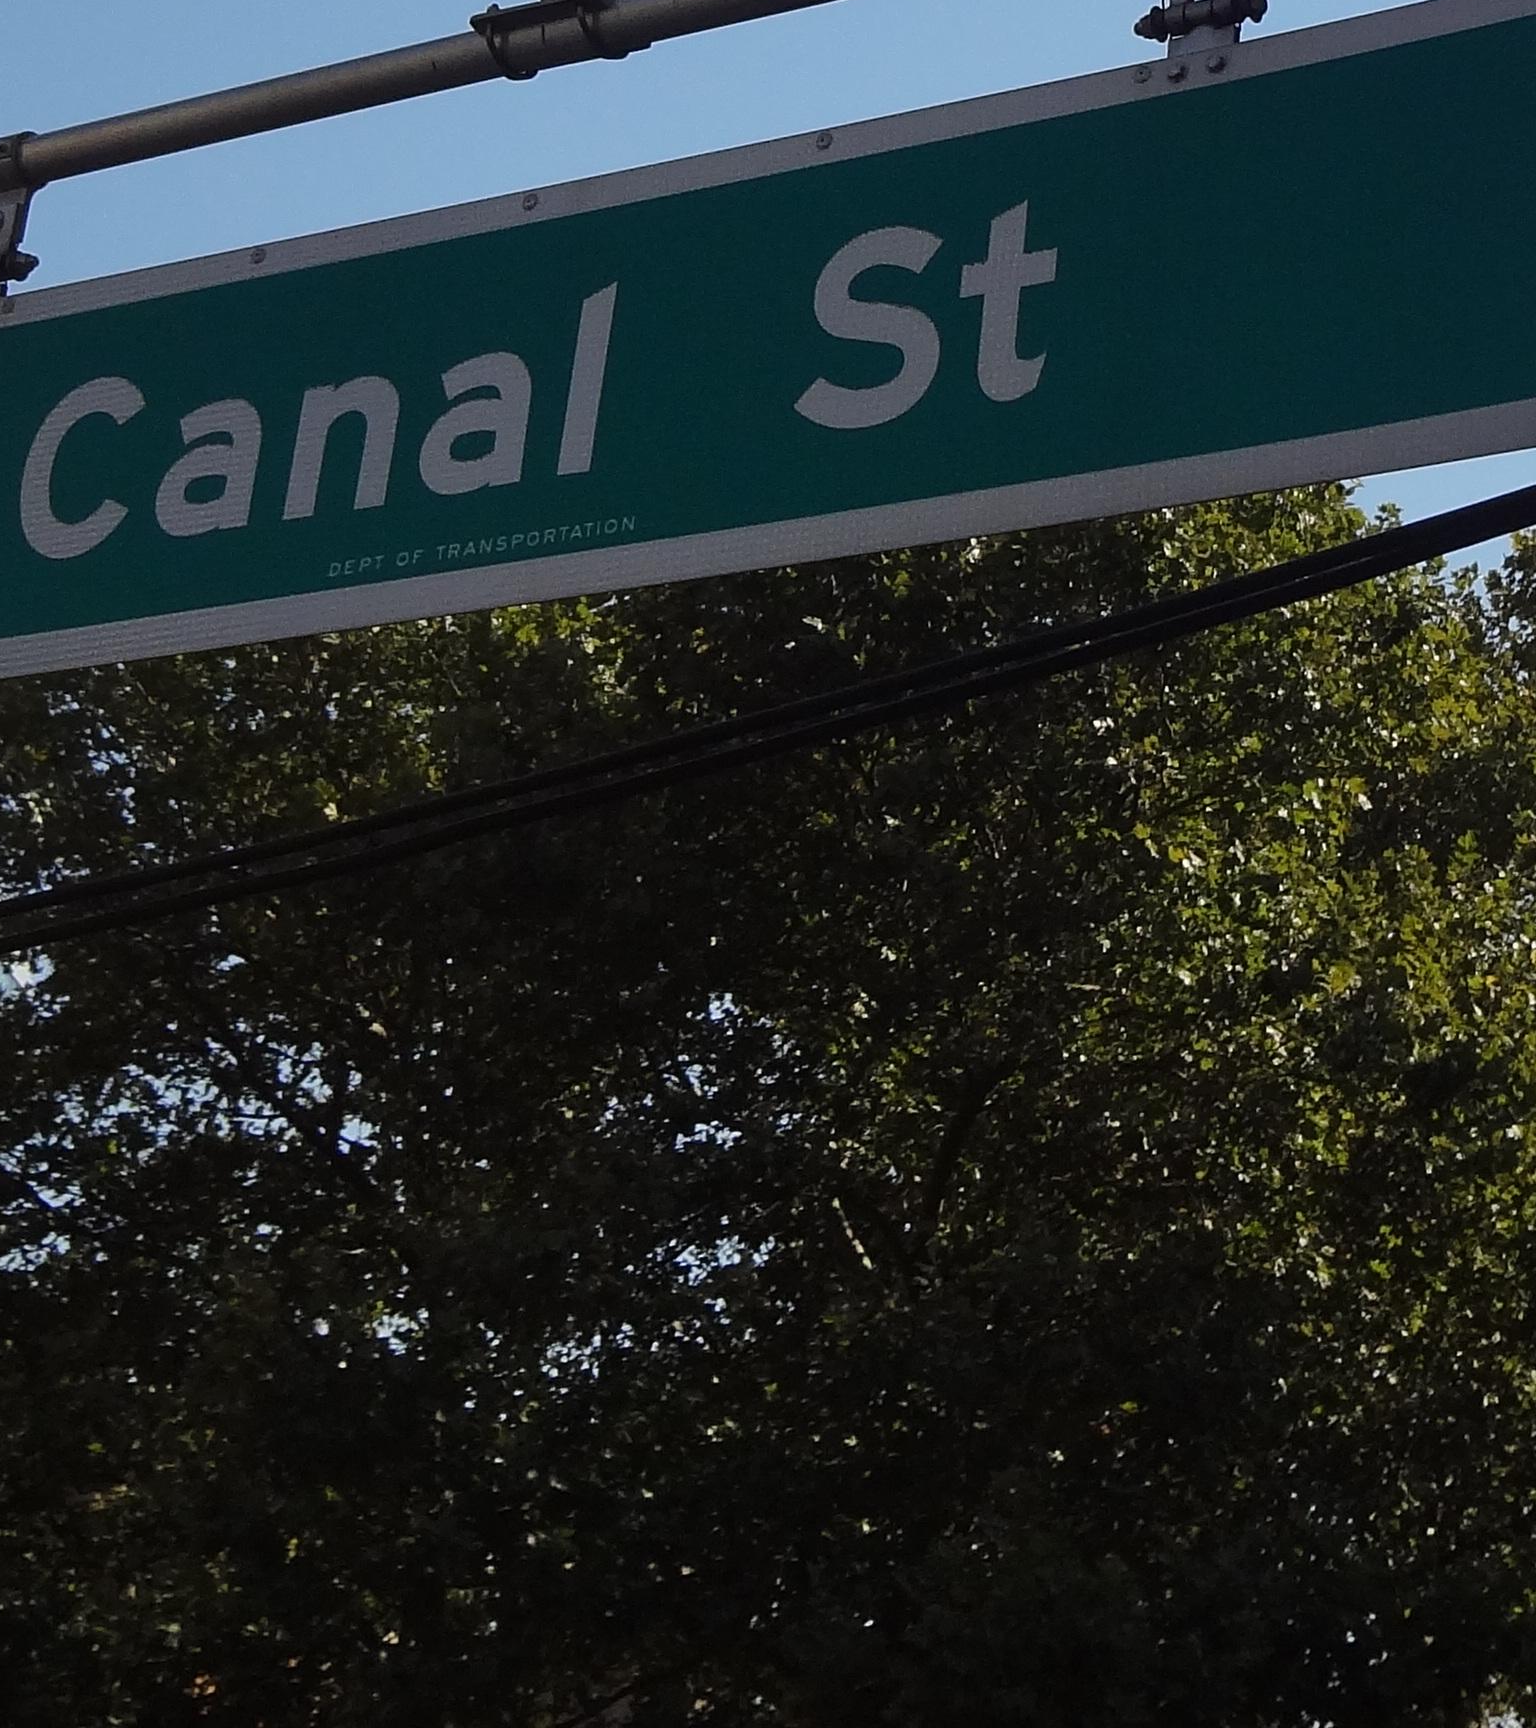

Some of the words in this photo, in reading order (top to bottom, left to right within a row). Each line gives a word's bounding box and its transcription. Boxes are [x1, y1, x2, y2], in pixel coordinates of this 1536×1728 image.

[20, 280, 618, 559] Canal
[794, 199, 1058, 429] St
[327, 555, 385, 578] DEPT
[396, 549, 425, 568] OF
[436, 515, 637, 561] TRANSPORTATION
